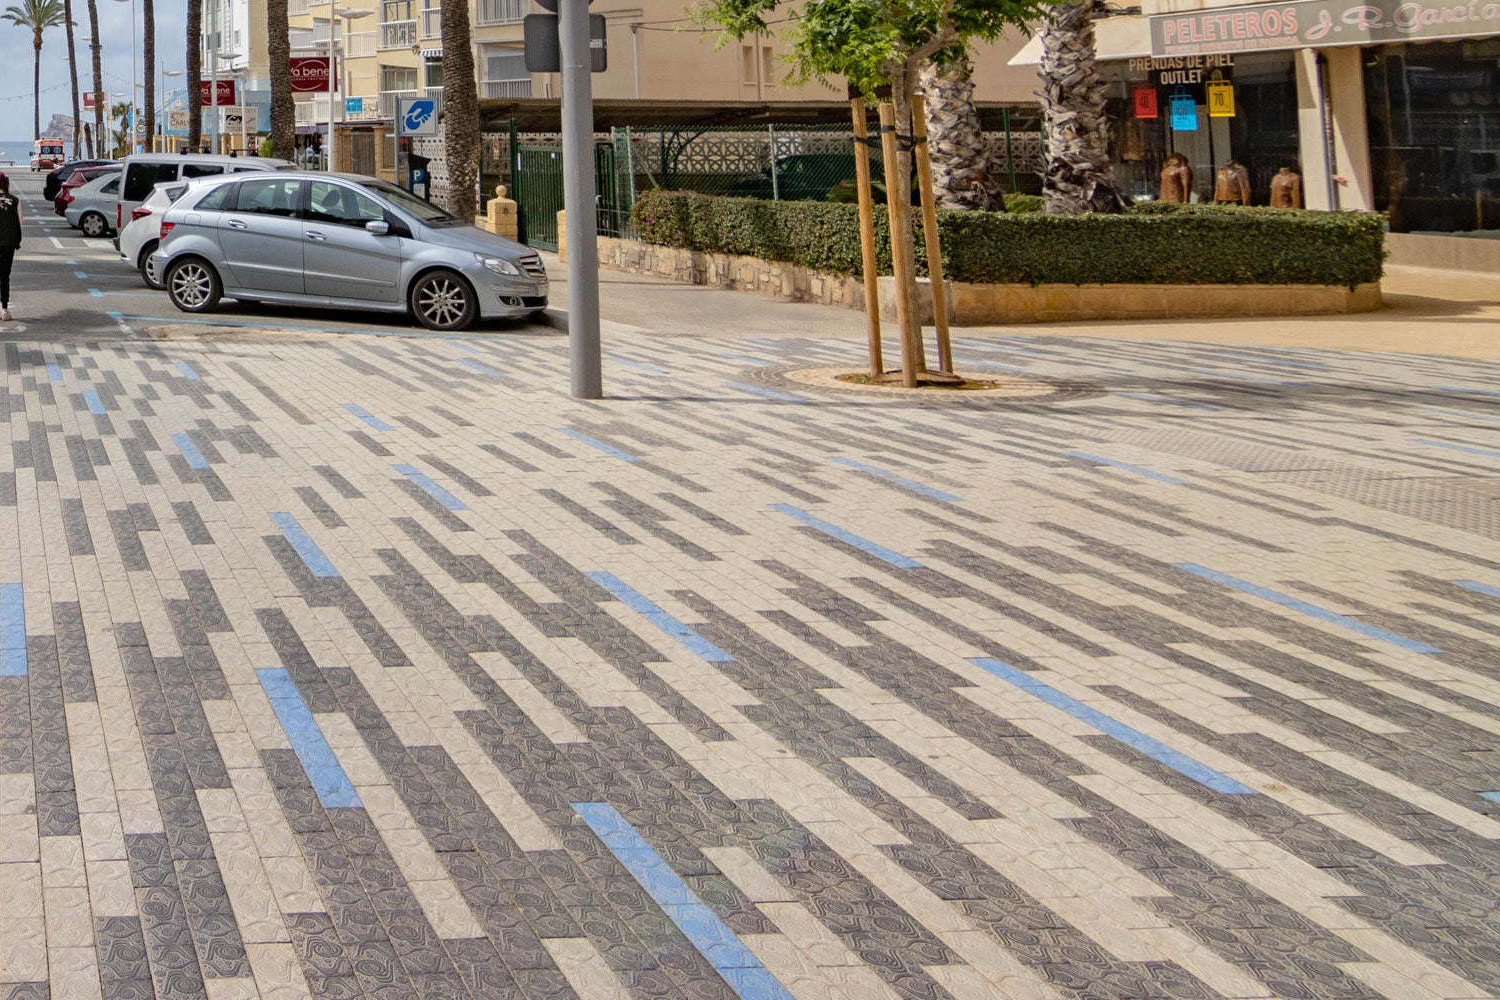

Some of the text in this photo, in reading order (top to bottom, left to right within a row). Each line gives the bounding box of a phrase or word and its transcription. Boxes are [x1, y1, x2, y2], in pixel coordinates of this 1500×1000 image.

[1163, 7, 1299, 44] PELETEROS
[1129, 54, 1235, 71] PRENDAS DE PIEL
[1160, 70, 1202, 85] OUTLET
